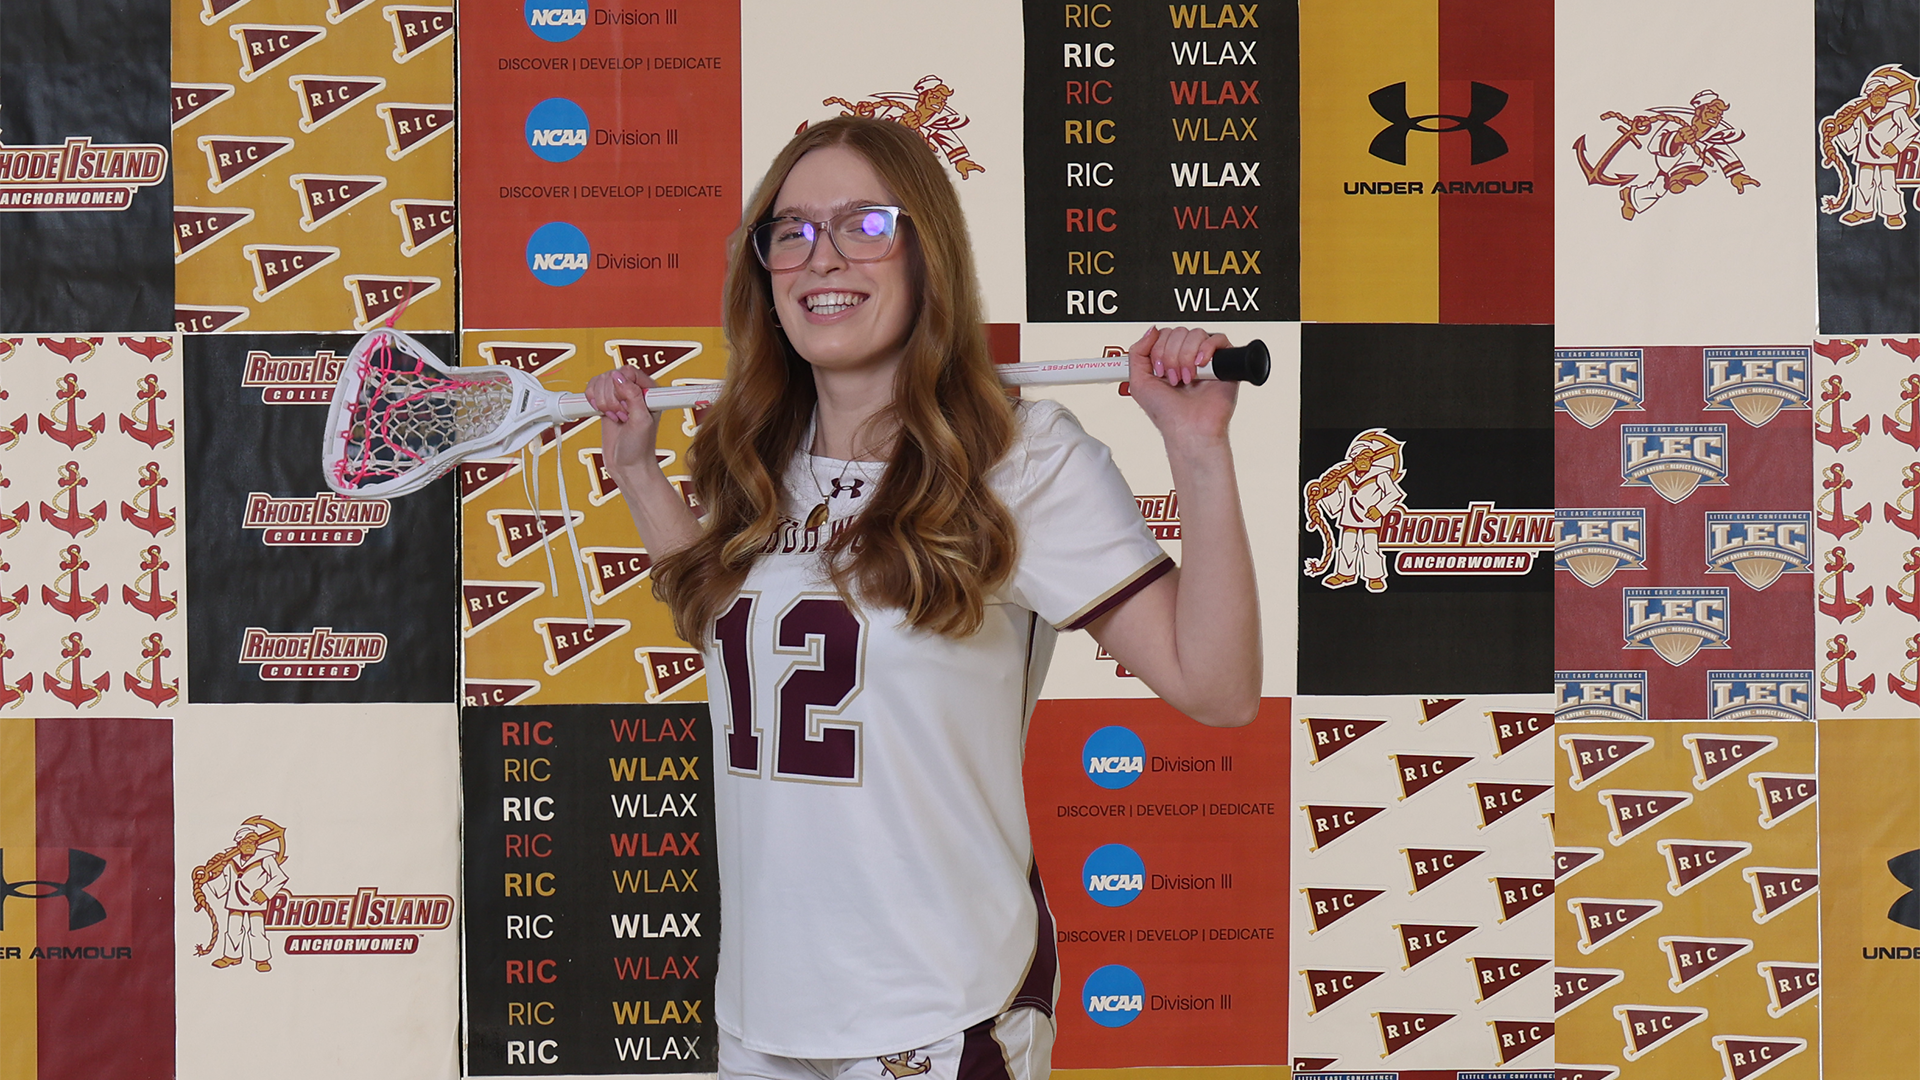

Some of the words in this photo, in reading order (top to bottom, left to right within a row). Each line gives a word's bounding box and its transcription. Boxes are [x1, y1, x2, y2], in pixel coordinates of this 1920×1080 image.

[531, 10, 586, 26] NCAA
[595, 9, 660, 26] Division
[666, 9, 677, 26] III
[1065, 4, 1112, 28] RIC
[1169, 4, 1259, 28] WLAX
[405, 16, 444, 38] RIC
[251, 35, 291, 56] RIC
[1064, 42, 1116, 68] RIC
[1171, 41, 1257, 65] WLAX
[499, 58, 568, 71] DISCOVER
[580, 57, 643, 71] DEVELOP
[654, 57, 721, 70] DEDICATE
[311, 86, 350, 107] RIC
[1066, 80, 1113, 104] RIC
[1170, 80, 1260, 104] WLAX
[398, 114, 438, 134] RIC
[1065, 120, 1116, 144] RIC
[1172, 117, 1258, 141] WLAX
[532, 130, 587, 146] NCAA
[595, 129, 661, 146] Division
[666, 129, 678, 145] III
[0, 152, 60, 180] HODE
[67, 145, 161, 180] ISLAND
[219, 146, 258, 167] RIC
[1067, 162, 1113, 187] RIC
[1171, 162, 1261, 187] WLAX
[1, 191, 125, 205] ANCHORWOMEN
[312, 185, 351, 205] RIC
[500, 186, 569, 199] DISCOVER
[581, 185, 644, 198] DEVELOP
[655, 185, 722, 198] DEDICATE
[1343, 182, 1424, 195] UNDER
[1431, 181, 1534, 194] ARMOUR
[180, 217, 219, 238] RIC
[412, 210, 452, 231] RIC
[1066, 207, 1117, 232] RIC
[1173, 205, 1259, 229] WLAX
[265, 256, 304, 276] RIC
[532, 254, 588, 270] NCAA
[596, 253, 662, 270] Division
[667, 253, 679, 269] III
[1068, 251, 1115, 275] RIC
[1172, 250, 1261, 275] WLAX
[365, 286, 404, 307] RIC
[1066, 289, 1118, 314] RIC
[1174, 287, 1260, 311] WLAX
[175, 315, 214, 333] RIC
[249, 356, 312, 381] RHODE
[627, 350, 665, 370] RIC
[1041, 363, 1075, 372] OFFSET
[1075, 361, 1122, 370] MAXIMUM
[1555, 361, 1637, 394] LEC
[1710, 360, 1804, 393] LEC
[273, 390, 329, 400] COLLE
[1627, 437, 1721, 469] LEC
[249, 498, 313, 523] RHODE
[317, 498, 386, 523] ISLAND
[273, 531, 354, 542] COLLEGE
[509, 518, 547, 541] RIC
[1378, 510, 1463, 543] RHODE
[1470, 510, 1555, 543] ISLAND
[1555, 521, 1639, 553] LEC
[1711, 524, 1806, 556] LEC
[602, 558, 641, 579] RIC
[1402, 556, 1526, 569] ANCHORWOMEN
[469, 591, 509, 612] RIC
[1630, 600, 1723, 632] LEC
[246, 633, 309, 658] RHODE
[313, 633, 382, 658] ISLAND
[556, 628, 595, 649] RIC
[270, 666, 350, 677] COLLEGE
[657, 657, 696, 679] RIC
[466, 689, 505, 707] RIC
[712, 590, 869, 787] 12
[1555, 683, 1641, 715] LEC
[1713, 683, 1808, 715] LEC
[502, 721, 554, 746] RIC
[611, 718, 697, 742] WLAX
[1316, 724, 1355, 745] RIC
[1500, 717, 1539, 738] RIC
[1089, 756, 1143, 774] NCAA
[1151, 756, 1216, 773] Division
[1221, 756, 1233, 772] III
[1580, 745, 1619, 765] RIC
[1704, 744, 1743, 765] RIC
[504, 758, 551, 782] RIC
[609, 757, 699, 781] WLAX
[1404, 760, 1444, 782] RIC
[1484, 788, 1523, 810] RIC
[1770, 783, 1809, 804] RIC
[503, 796, 555, 821] RIC
[611, 794, 698, 818] WLAX
[1057, 804, 1125, 818] DISCOVER
[1136, 804, 1198, 817] DEVELOP
[1209, 803, 1274, 816] DEDICATE
[1620, 800, 1658, 821] RIC
[1316, 811, 1355, 832] RIC
[505, 834, 552, 857] RIC
[610, 833, 700, 856] WLAX
[1415, 854, 1454, 876] RIC
[1679, 850, 1717, 871] RIC
[504, 873, 556, 897] RIC
[612, 870, 698, 893] WLAX
[1089, 874, 1143, 891] NCAA
[1151, 874, 1216, 890] Division
[1221, 873, 1233, 890] III
[1764, 878, 1803, 899] RIC
[1315, 893, 1354, 915] RIC
[1504, 883, 1543, 904] RIC
[265, 893, 350, 926] RHODE
[356, 892, 449, 926] ISLAND
[1589, 908, 1627, 929] RIC
[506, 915, 553, 939] RIC
[611, 914, 701, 938] WLAX
[1057, 929, 1125, 942] DISCOVER
[1136, 929, 1198, 942] DEVELOP
[1209, 928, 1274, 941] DEDICATE
[289, 938, 414, 951] ANCHORWOMEN
[1407, 930, 1447, 952] RIC
[29, 946, 132, 960] ARMOUR
[1680, 947, 1718, 968] RIC
[1862, 946, 1920, 960] UNDE
[506, 960, 557, 984] RIC
[614, 957, 700, 980] WLAX
[1481, 963, 1521, 984] RIC
[1315, 975, 1354, 997] RIC
[1555, 977, 1589, 997] RIC
[1779, 972, 1817, 993] RIC
[508, 1002, 555, 1025] RIC
[612, 1001, 702, 1024] WLAX
[1089, 995, 1143, 1012] NCAA
[1151, 995, 1216, 1011] Division
[1220, 994, 1232, 1011] III
[1386, 1017, 1426, 1039] RIC
[1635, 1015, 1673, 1036] RIC
[1502, 1026, 1541, 1047] RIC
[507, 1040, 559, 1065] RIC
[615, 1037, 700, 1061] WLAX
[1733, 1046, 1772, 1067] RIC
